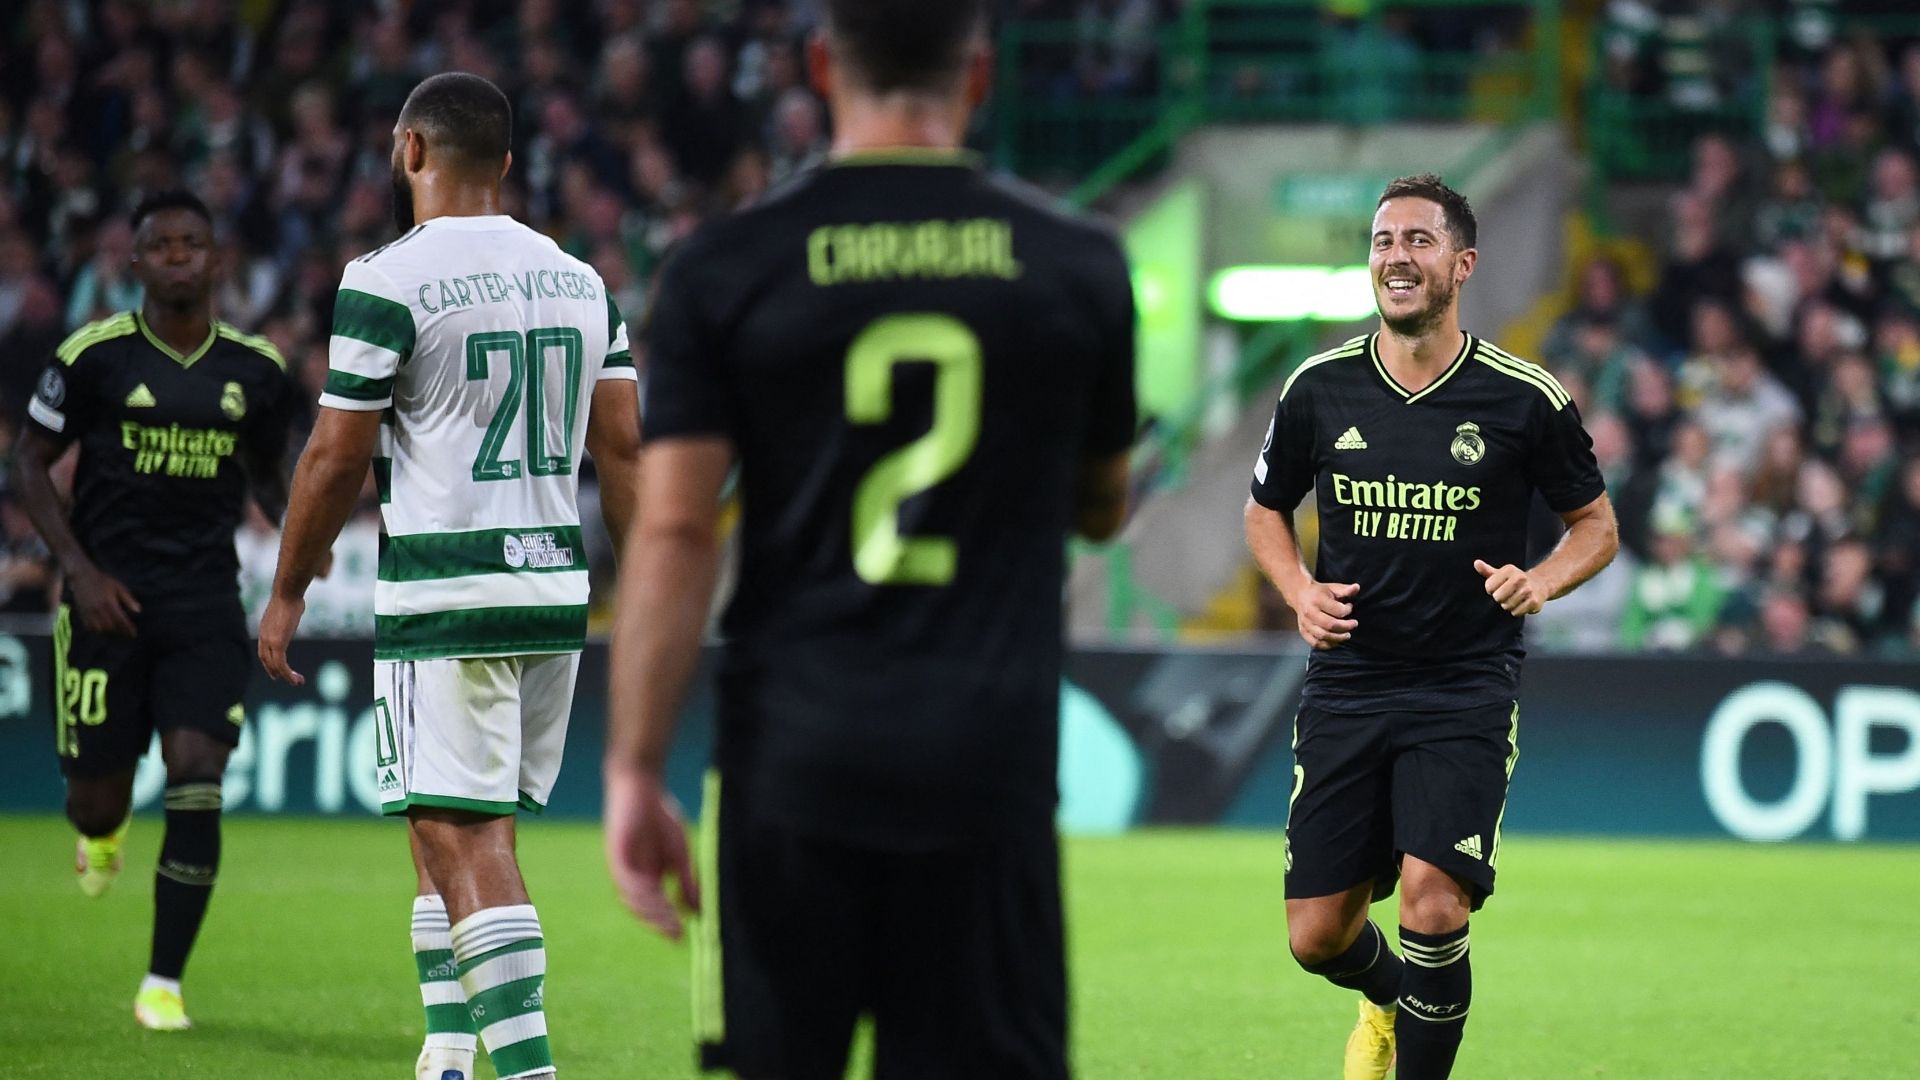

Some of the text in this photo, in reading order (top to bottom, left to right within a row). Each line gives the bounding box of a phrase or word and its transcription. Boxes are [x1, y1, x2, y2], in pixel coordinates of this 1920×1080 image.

[806, 219, 1021, 285] CARVAJAL
[419, 269, 598, 315] CARTER-VICKERS
[466, 327, 583, 482] 20
[844, 313, 984, 586] 2
[1335, 441, 1368, 450] adidas
[1332, 473, 1481, 511] Emirates
[1353, 510, 1457, 542] FLY BETTER
[64, 667, 108, 725] 20
[1701, 678, 1920, 842] OP
